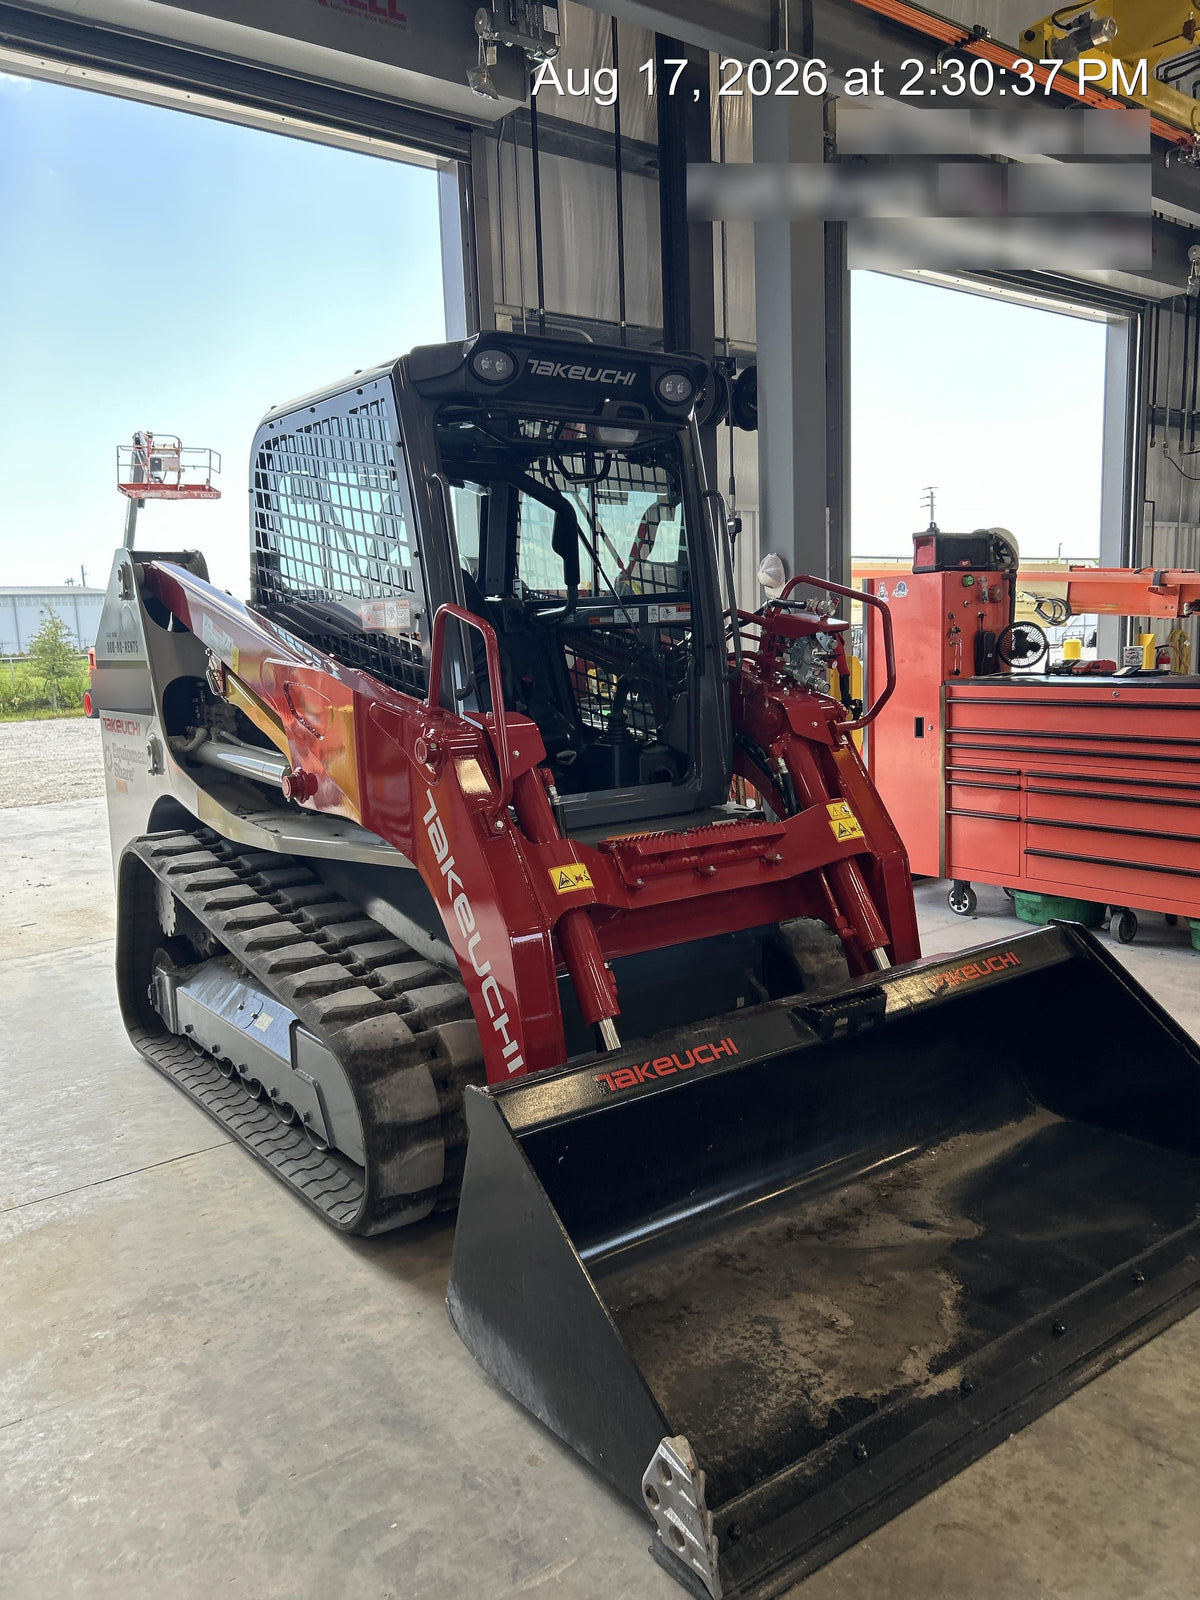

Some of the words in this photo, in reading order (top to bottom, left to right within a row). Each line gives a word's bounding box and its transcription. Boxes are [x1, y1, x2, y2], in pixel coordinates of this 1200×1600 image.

[527, 359, 637, 386] TAKEUCHI
[102, 717, 142, 736] TAKEUCHI
[422, 788, 525, 1074] TAKEUCHI
[597, 1037, 739, 1092] TAKEUCHI
